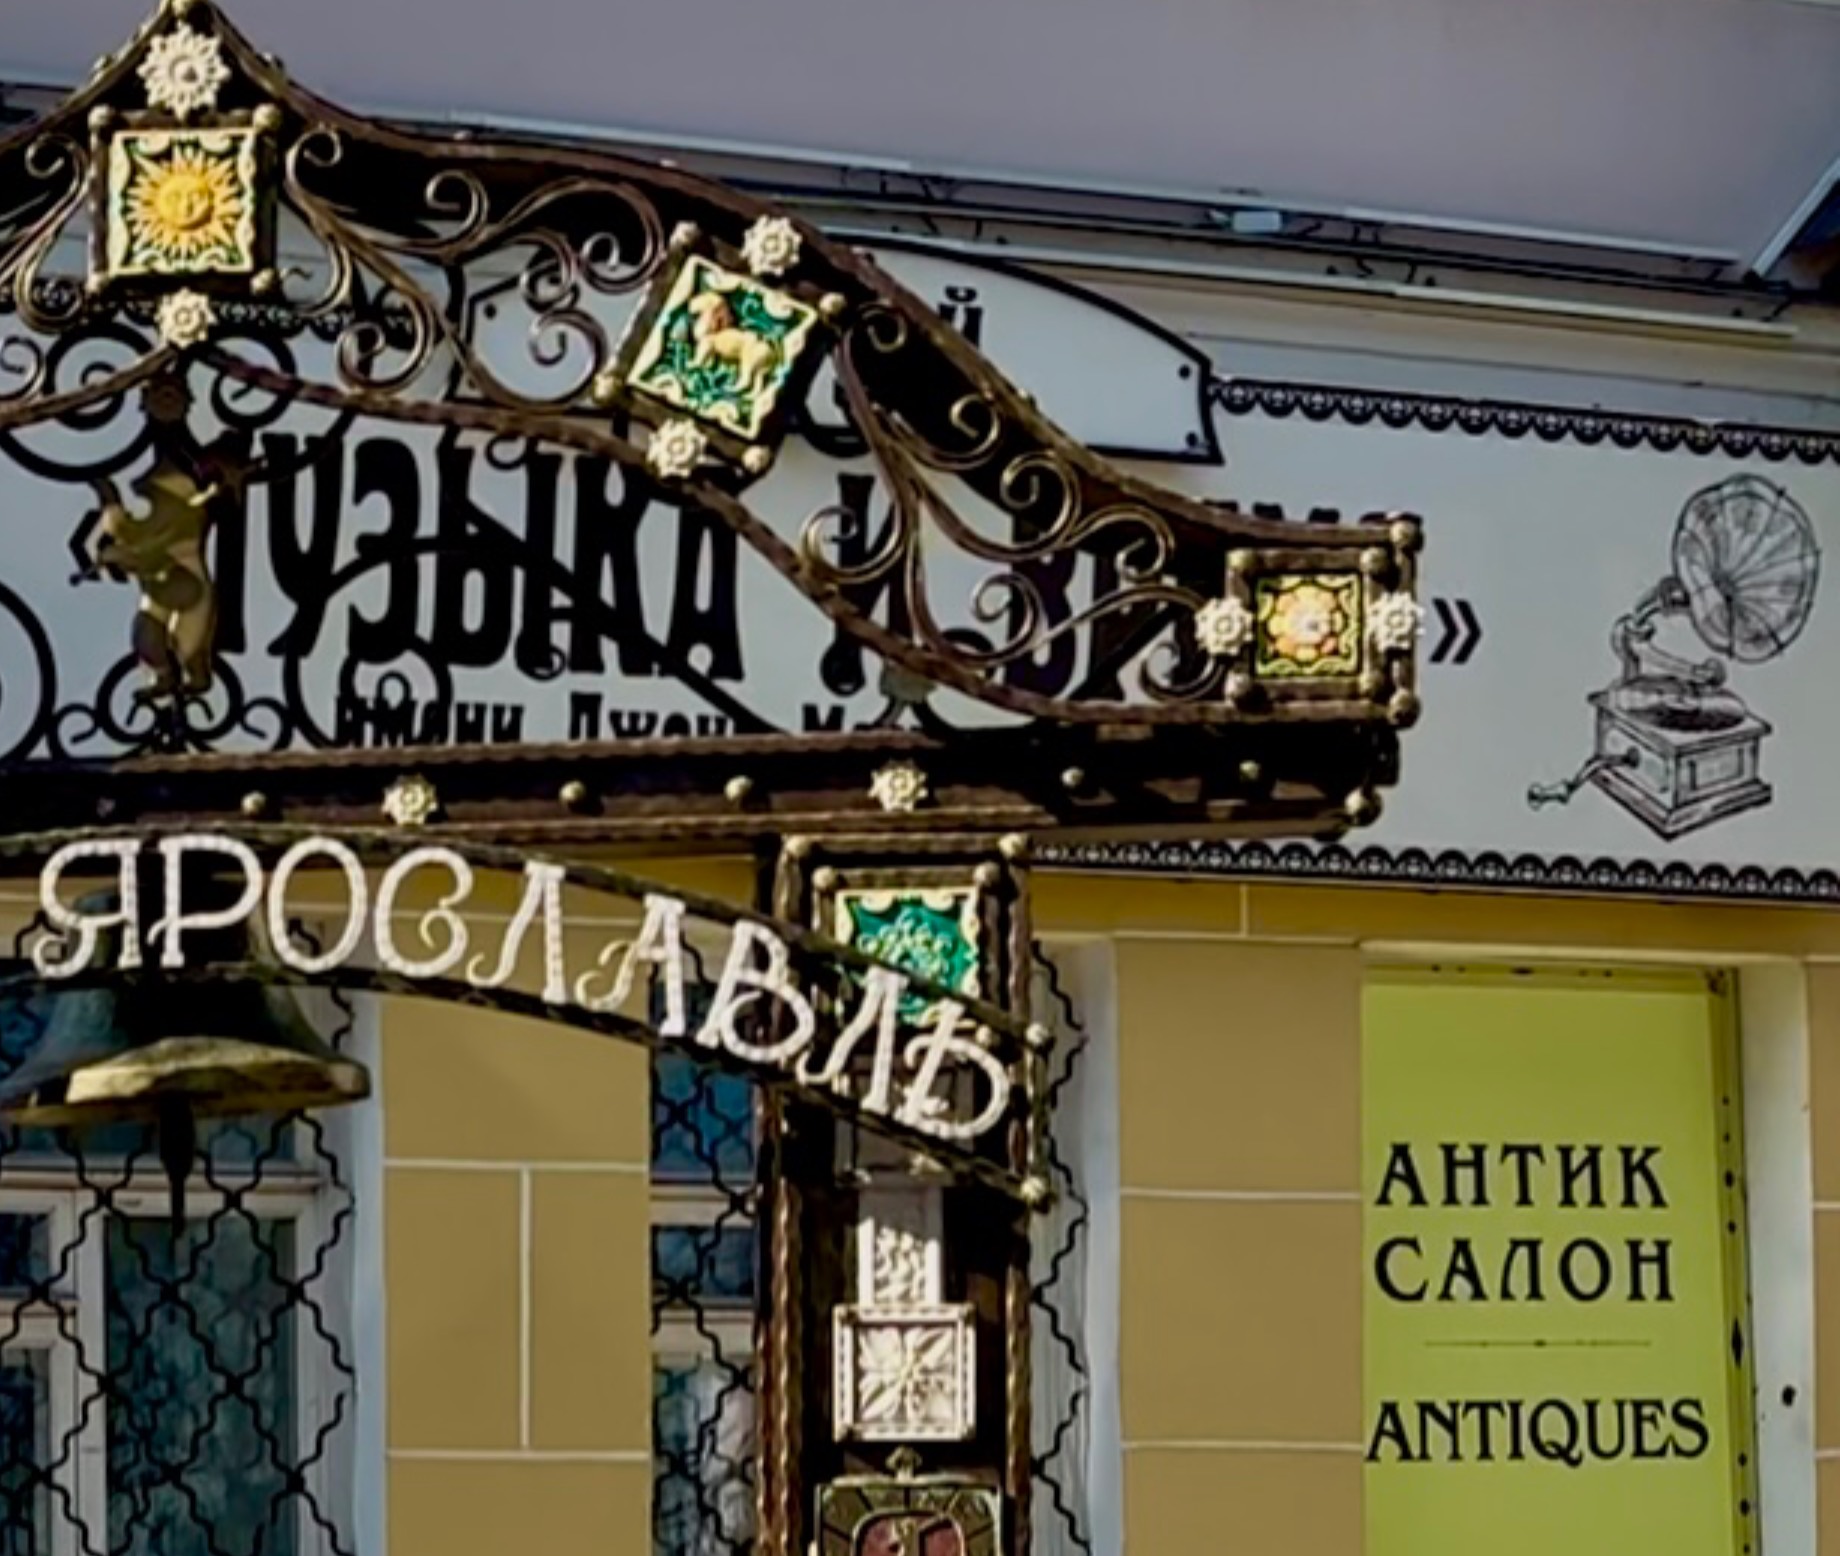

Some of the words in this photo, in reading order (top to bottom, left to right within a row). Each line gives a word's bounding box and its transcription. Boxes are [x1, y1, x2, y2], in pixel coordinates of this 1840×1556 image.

[33, 833, 1010, 1140] ЯРОСЛАВЛЬ
[1374, 1142, 1669, 1208] АНТИК
[1374, 1236, 1675, 1302] САЛОН
[1365, 1398, 1711, 1468] ANTIQUES
